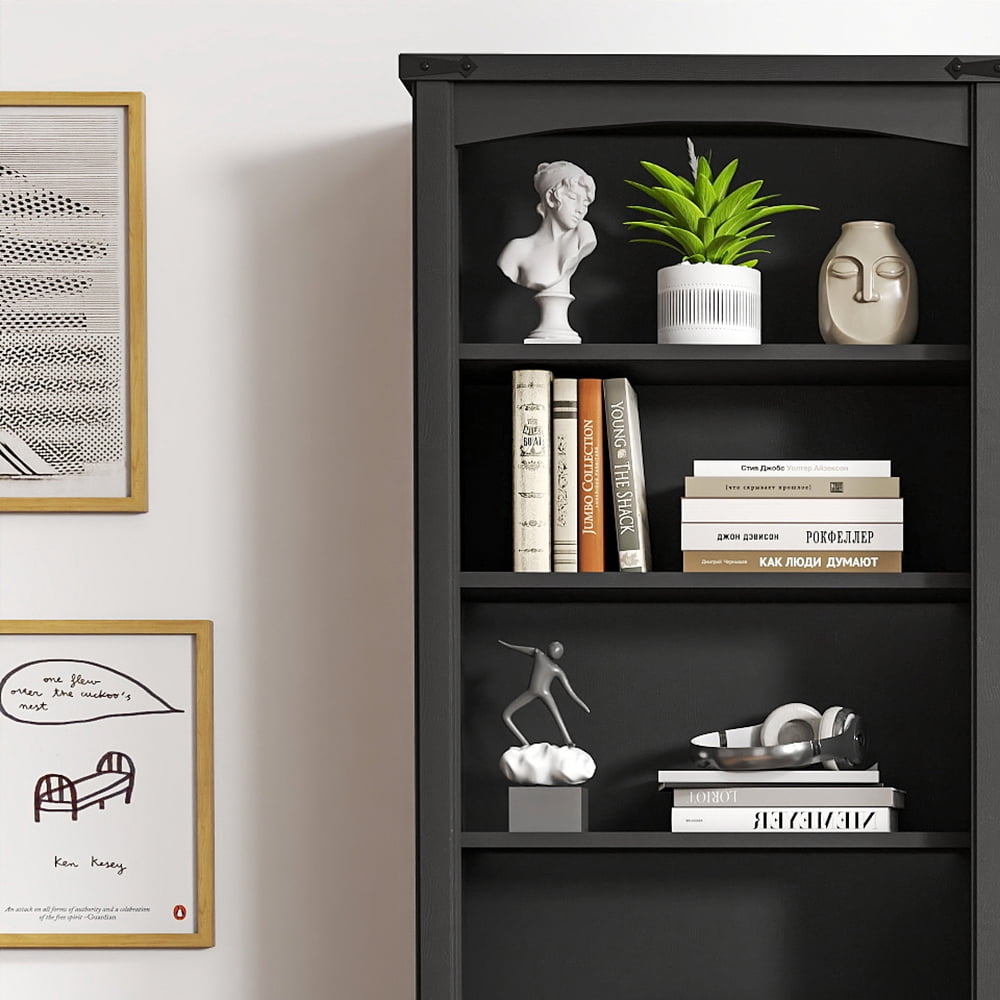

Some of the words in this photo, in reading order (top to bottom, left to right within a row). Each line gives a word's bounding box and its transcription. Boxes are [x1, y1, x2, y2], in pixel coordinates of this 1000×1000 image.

[610, 400, 626, 449] YOUNG
[614, 461, 630, 489] THE
[760, 464, 785, 472] Джобс
[616, 490, 635, 535] SHACK
[806, 530, 874, 544] РОКФЕЛЛЕР
[759, 557, 783, 568] КАК
[785, 557, 822, 569] ЛЮДИ
[826, 557, 879, 569] ДУМАЮТ
[43, 676, 63, 684] one
[70, 673, 101, 688] flew
[52, 688, 74, 698] the
[80, 690, 131, 701] cuckoo's
[19, 702, 48, 712] nest
[54, 855, 79, 868] Ken
[91, 855, 127, 875] Kesey
